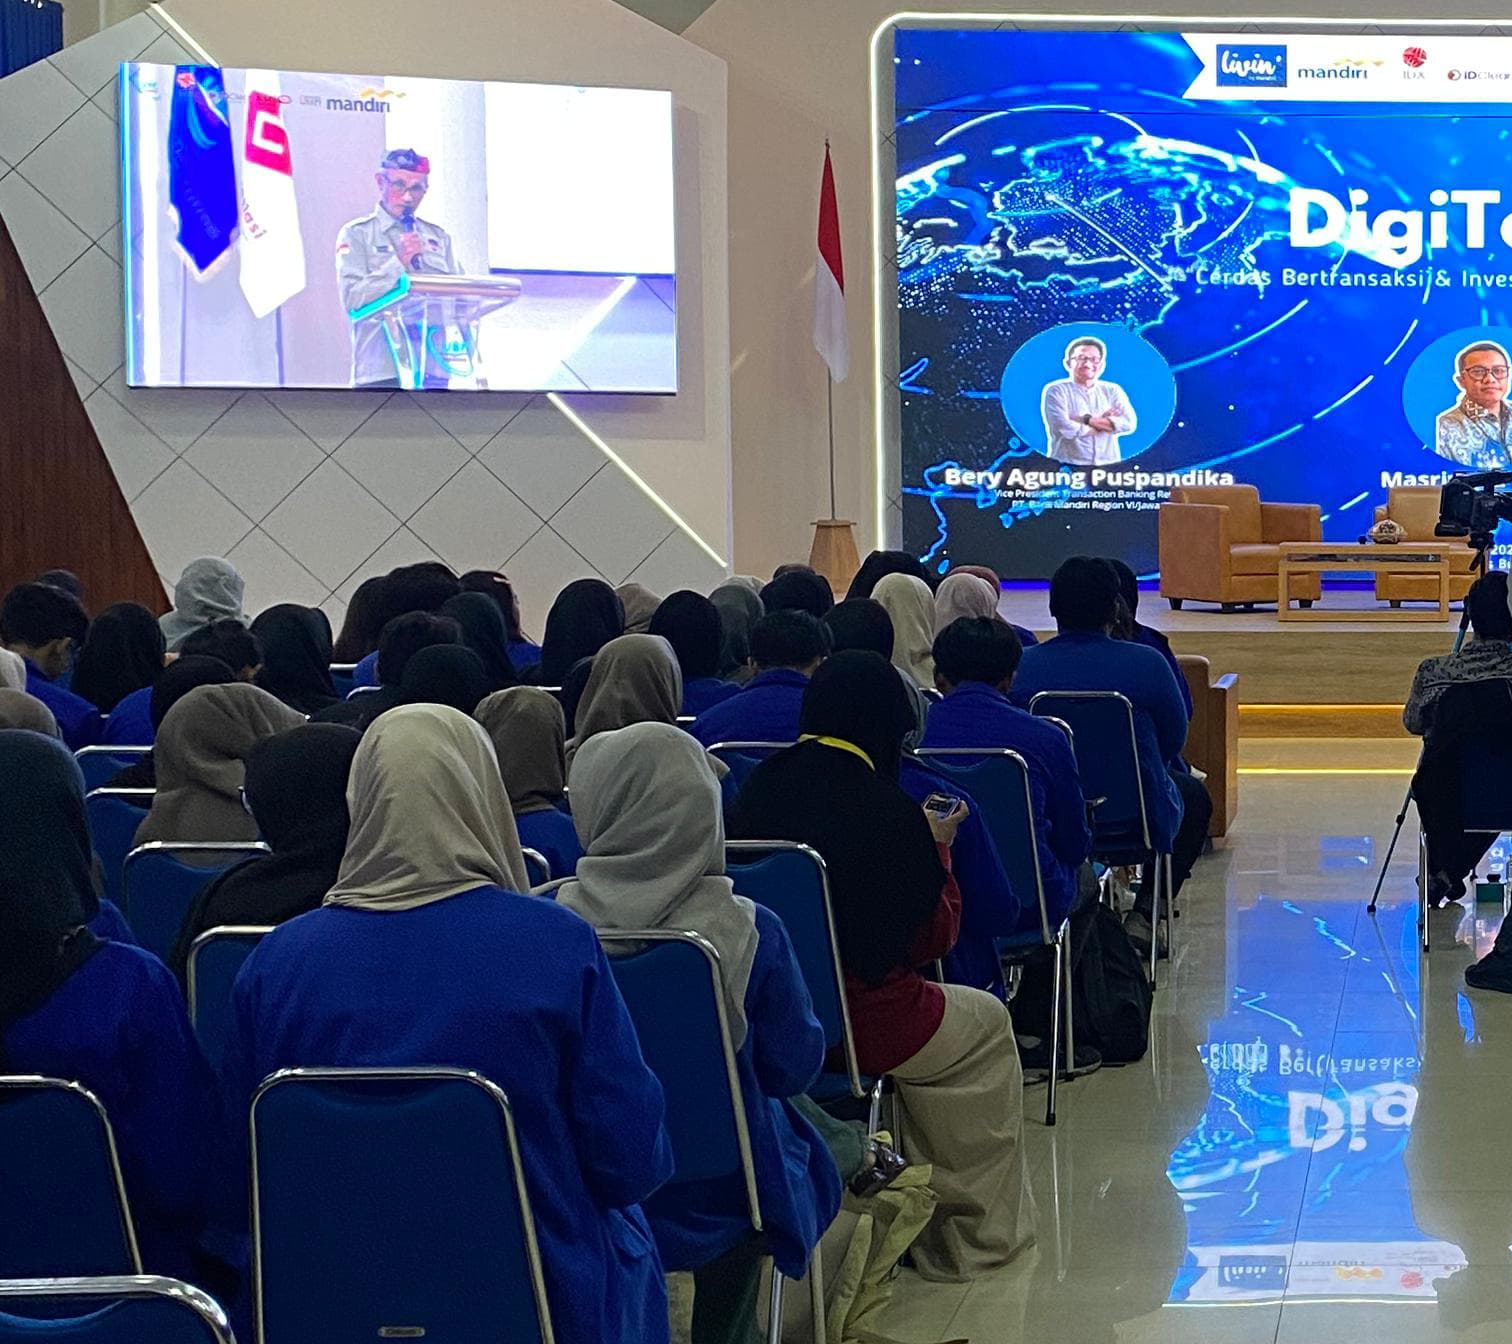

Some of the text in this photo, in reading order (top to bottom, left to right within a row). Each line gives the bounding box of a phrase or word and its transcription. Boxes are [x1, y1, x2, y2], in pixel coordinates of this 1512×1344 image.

[1298, 64, 1368, 79] mandiri
[1282, 268, 1424, 287] Bertransaksi
[1435, 269, 1451, 287] &
[945, 467, 1234, 490] Bery Agung Puspandika
[1118, 489, 1155, 501] Banking
[1092, 501, 1124, 511] Region
